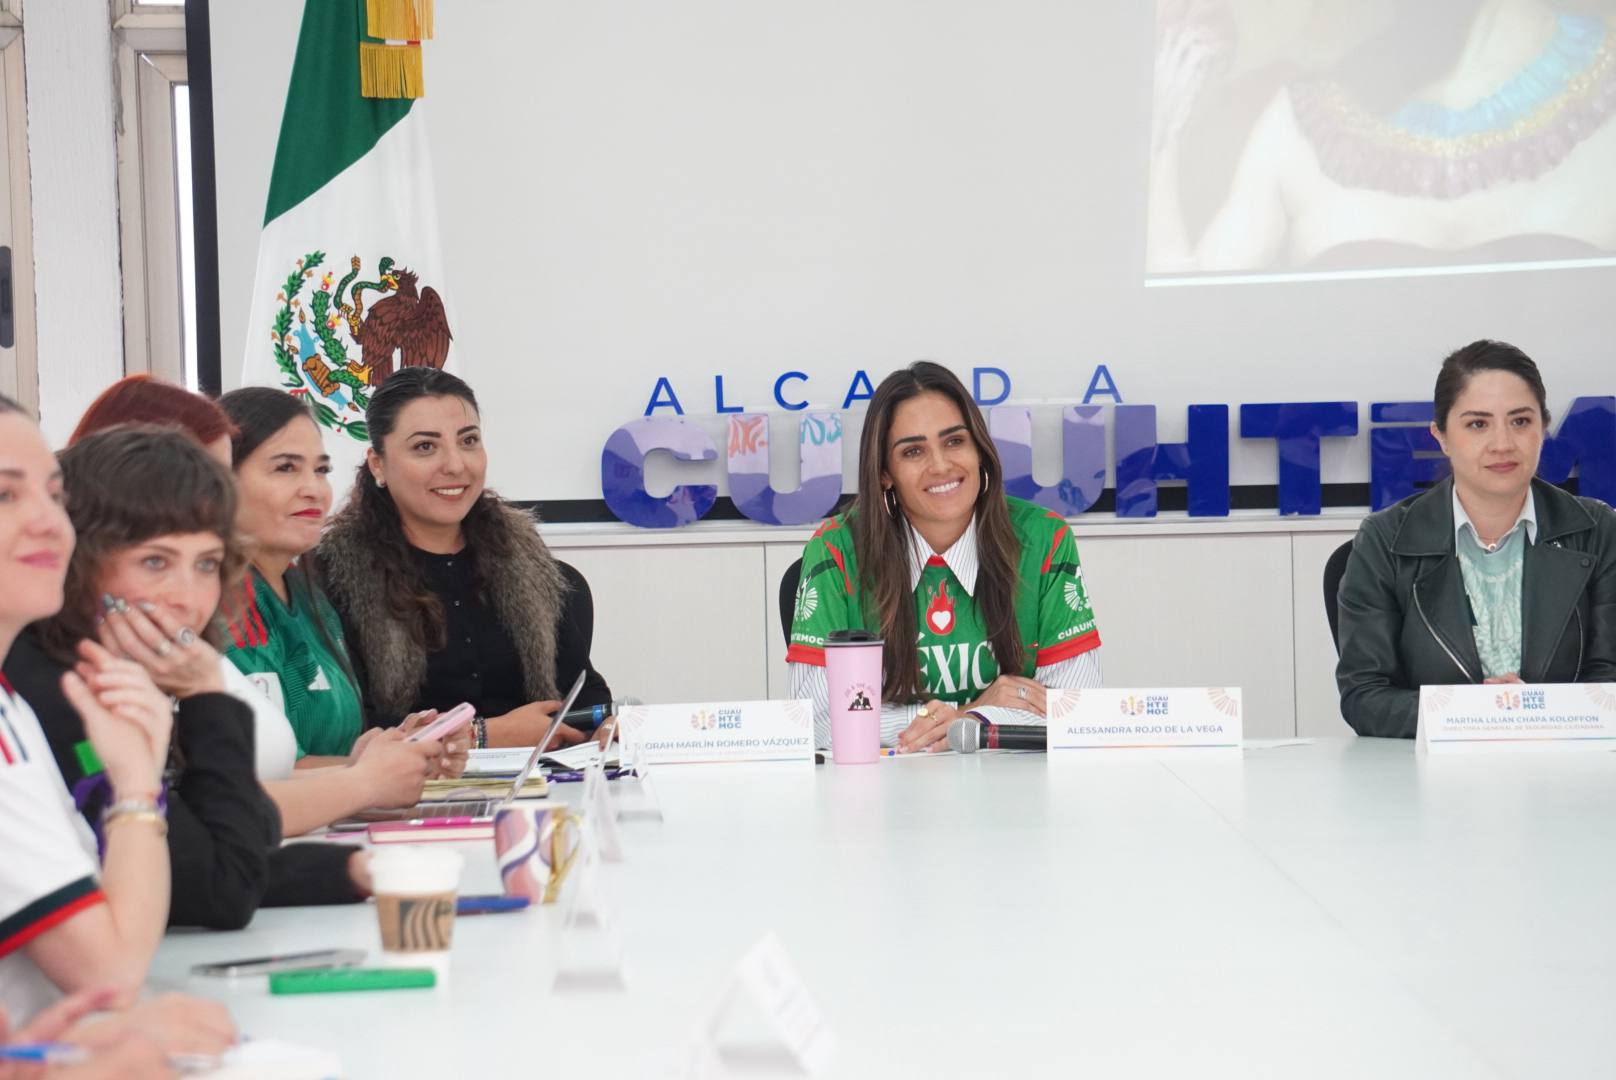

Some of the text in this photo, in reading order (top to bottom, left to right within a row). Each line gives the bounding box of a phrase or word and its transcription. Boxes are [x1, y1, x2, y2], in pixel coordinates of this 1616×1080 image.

[1446, 717, 1484, 725] MARTHA
[1486, 716, 1515, 724] LILIAN
[1067, 726, 1133, 735] ALESSANDRA
[1135, 726, 1162, 734] ROJO
[1180, 725, 1194, 733] LA
[1196, 725, 1224, 733] VEGA
[716, 739, 760, 748] ROMERO
